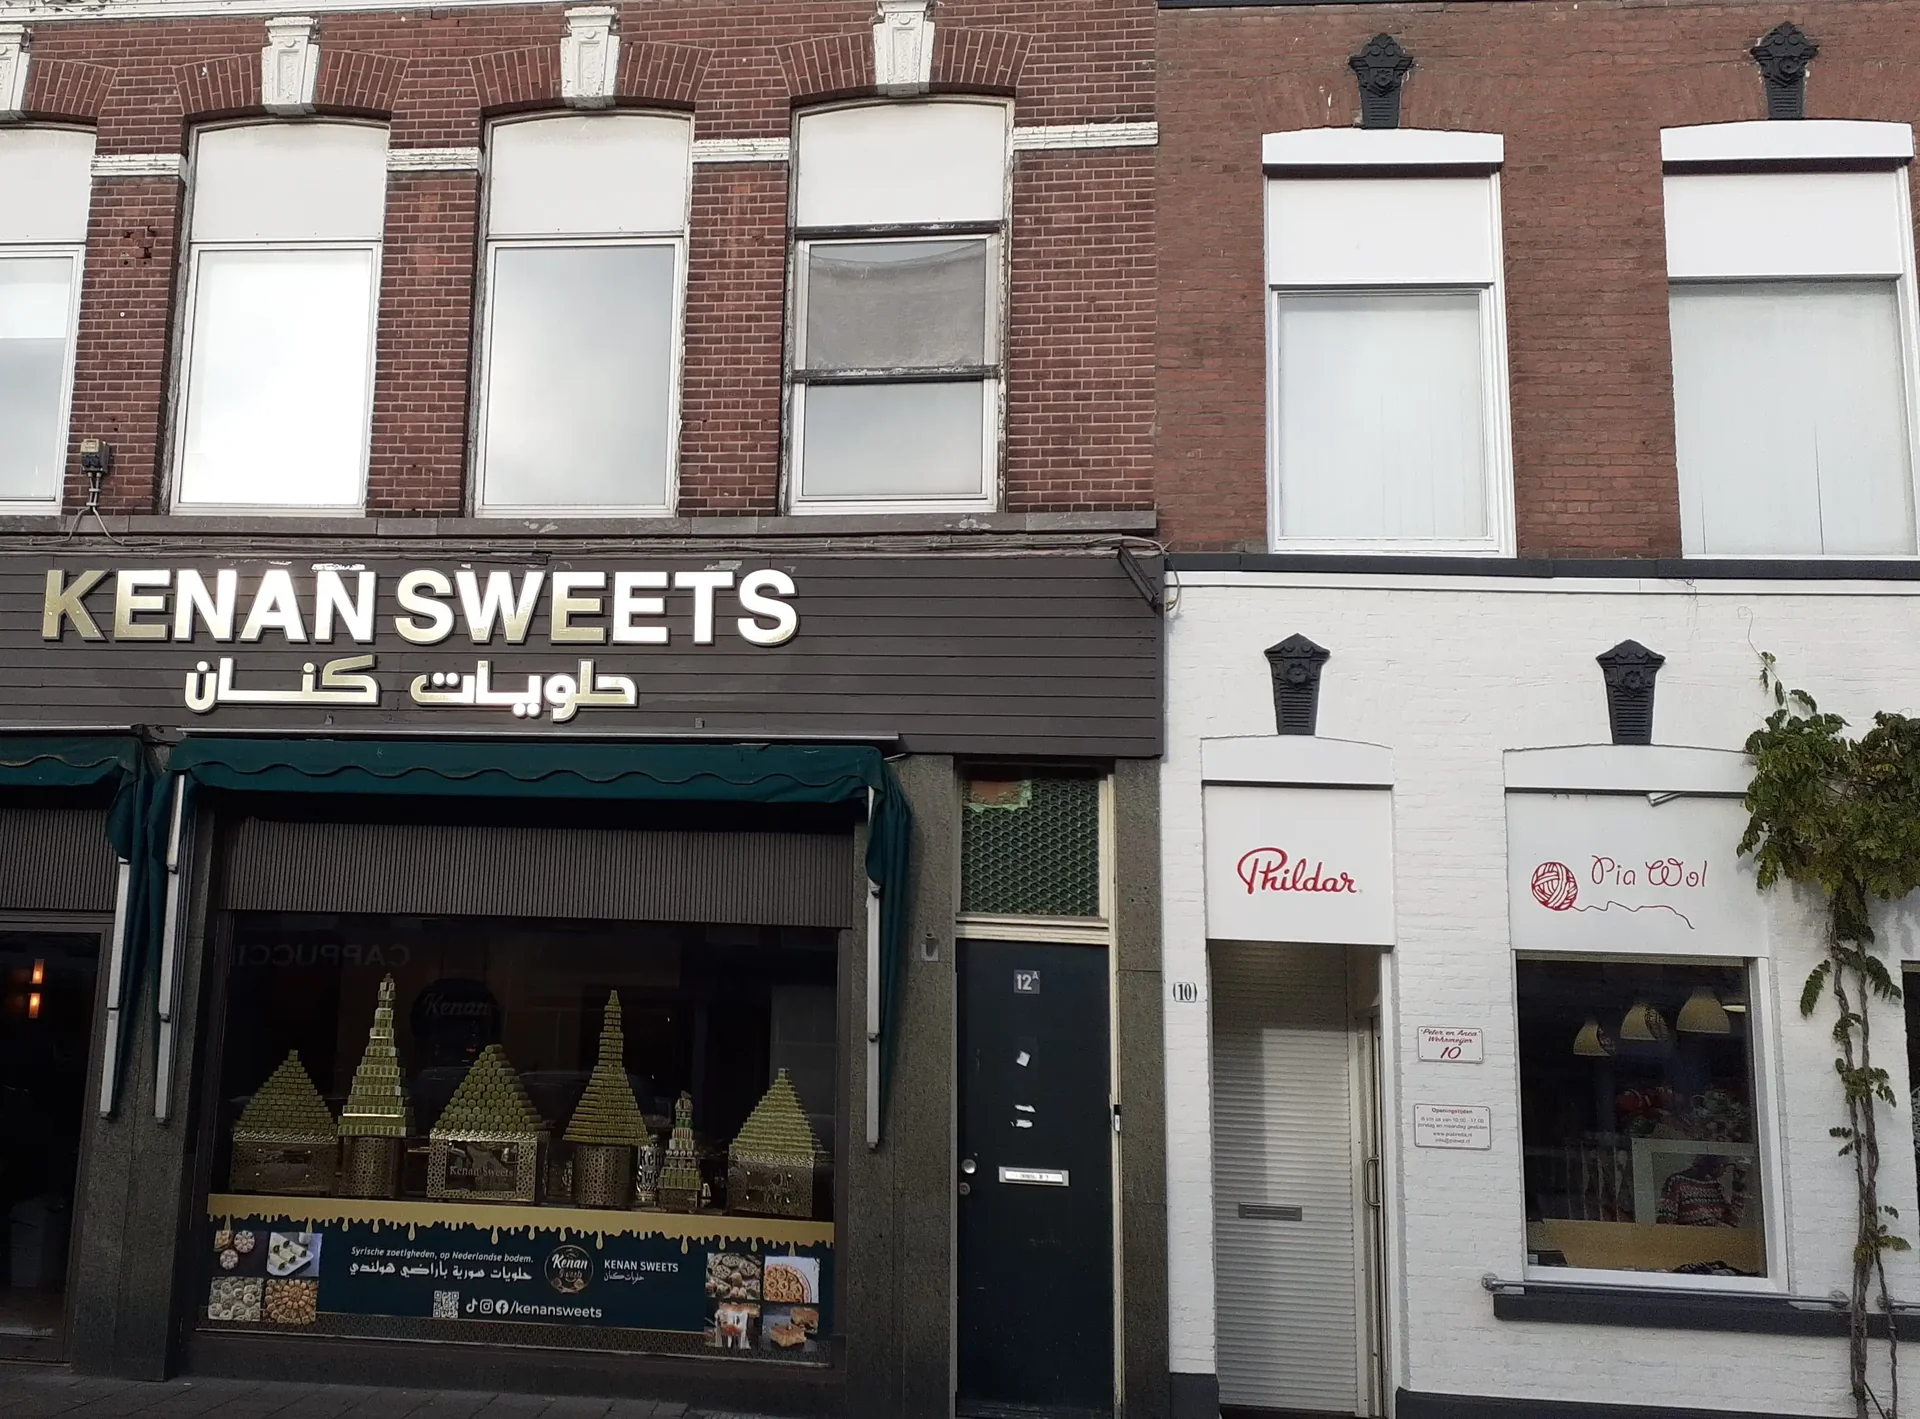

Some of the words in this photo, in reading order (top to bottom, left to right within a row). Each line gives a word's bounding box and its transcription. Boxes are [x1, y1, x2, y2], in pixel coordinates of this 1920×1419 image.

[41, 568, 376, 643] KENAN
[394, 568, 798, 647] SWEETS
[185, 654, 380, 713] كنان
[409, 659, 639, 722] حلويات
[1237, 847, 1357, 894] Phildar
[1591, 855, 1636, 885] Pia
[1645, 857, 1708, 887] Wol
[1178, 983, 1192, 1001] 10
[422, 991, 491, 1018] Kenan
[1440, 1046, 1462, 1060] 10
[449, 1165, 479, 1176] Kenan
[351, 1246, 385, 1258] Syrische
[386, 1247, 438, 1260] zoetigheden,
[439, 1251, 451, 1261] op
[452, 1251, 502, 1262] Nederlandse
[504, 1254, 534, 1264] bodem.
[551, 1253, 589, 1270] Kenan
[349, 1259, 396, 1276] هولندي
[452, 1264, 486, 1280] سورية
[490, 1266, 533, 1282] حلويات
[604, 1259, 638, 1271] KENAN
[640, 1261, 679, 1273] SWEETS
[510, 1300, 602, 1319] /kenansweets
